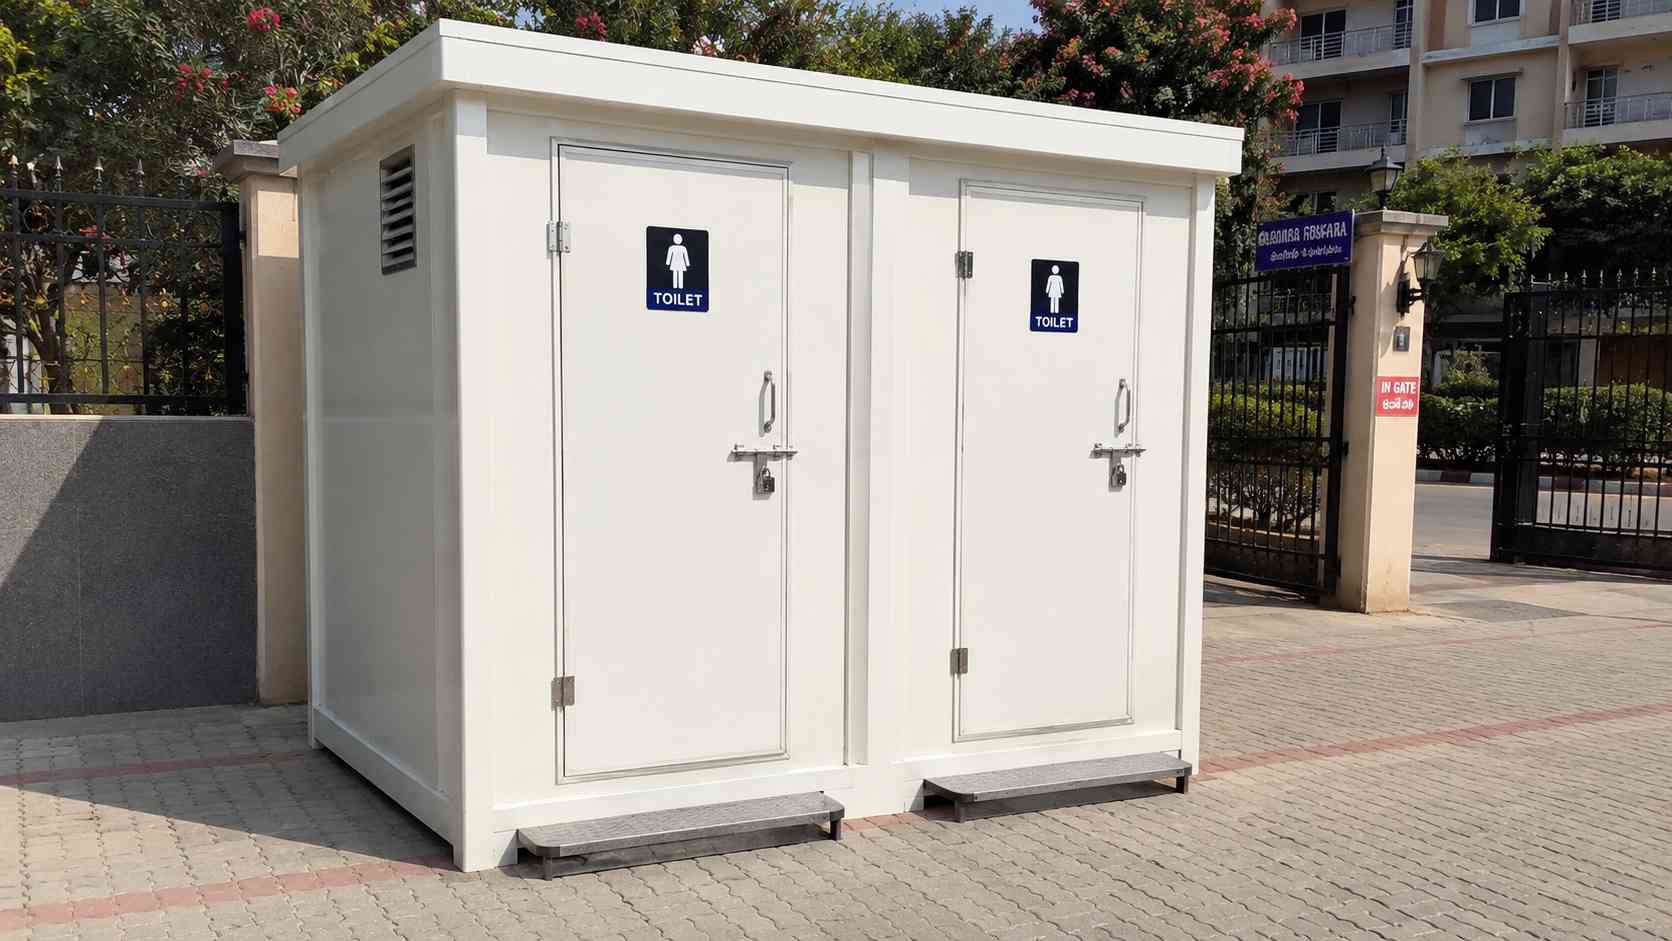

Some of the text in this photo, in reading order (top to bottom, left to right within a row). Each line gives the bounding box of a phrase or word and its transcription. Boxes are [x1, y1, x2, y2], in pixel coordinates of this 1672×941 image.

[653, 292, 703, 306] TOILET
[1035, 316, 1074, 328] TOILET
[1381, 381, 1417, 394] IN GATE
